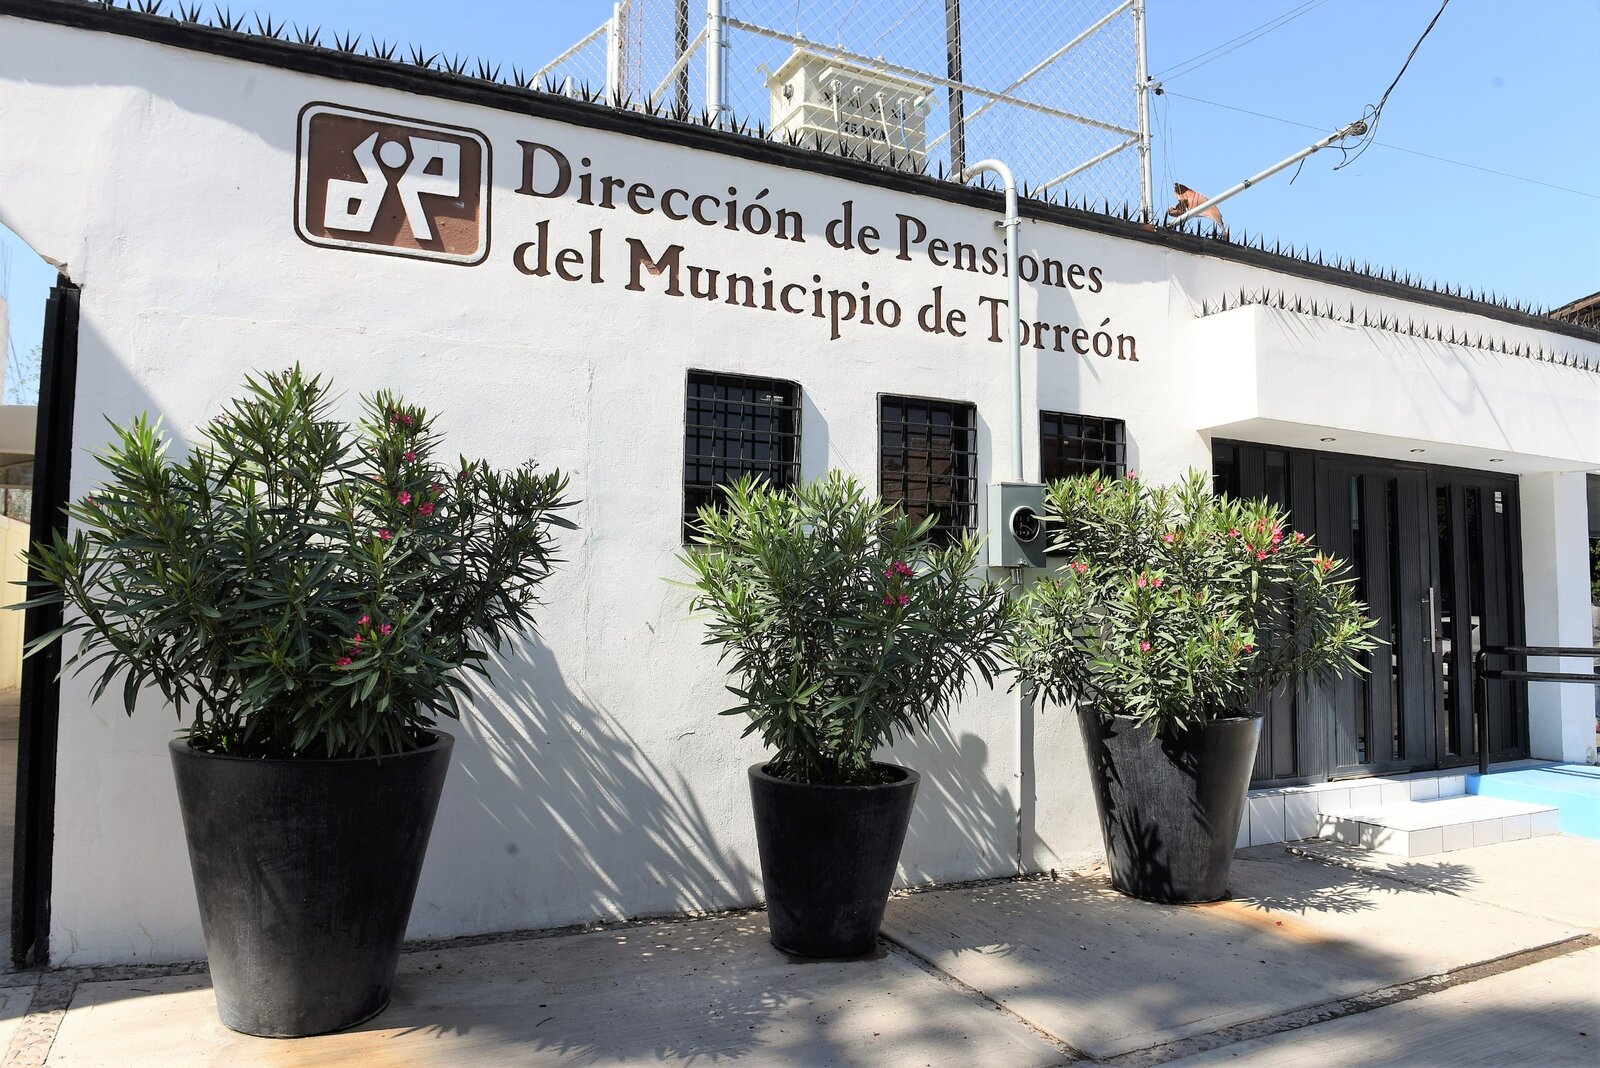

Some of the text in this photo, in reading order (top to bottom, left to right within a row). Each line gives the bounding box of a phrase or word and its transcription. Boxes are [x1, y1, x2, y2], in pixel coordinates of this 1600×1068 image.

[844, 121, 858, 134] 75
[514, 140, 1103, 294] Dirección de Pensiones
[513, 219, 605, 284] del
[625, 238, 902, 341] Municipio
[918, 286, 967, 339] de
